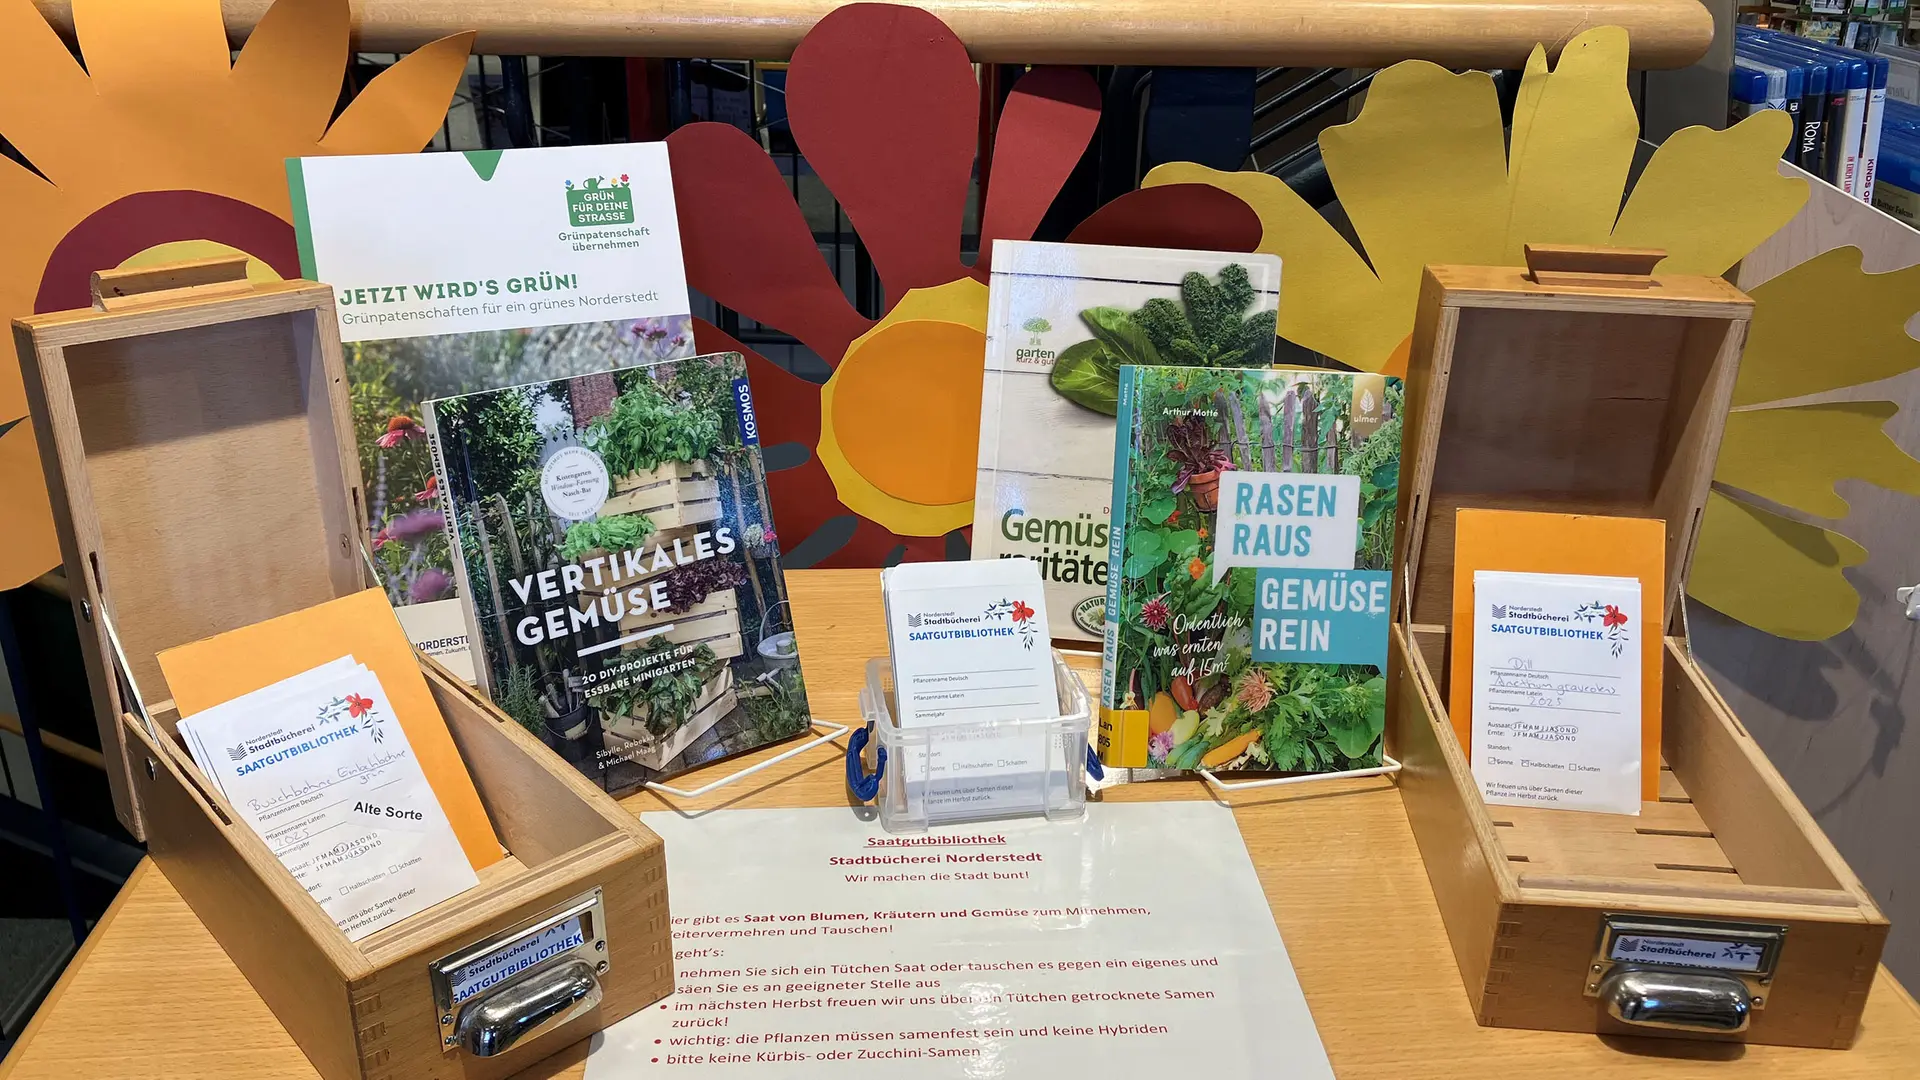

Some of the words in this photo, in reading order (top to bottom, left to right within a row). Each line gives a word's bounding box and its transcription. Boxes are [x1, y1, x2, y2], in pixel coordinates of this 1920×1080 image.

[1802, 121, 1821, 153] ROMA
[1865, 158, 1875, 188] KINDS
[573, 202, 593, 212] FÜR
[596, 201, 628, 211] DEINE
[584, 191, 614, 201] GRÜN
[578, 212, 625, 222] STRASSE
[559, 227, 650, 241] Grünpatenschaft
[573, 241, 639, 251] übernehmen
[339, 286, 407, 306] JETZT
[413, 279, 499, 301] WIRD'S
[506, 271, 578, 294] GRÜN!
[342, 304, 478, 325] Grünpatenschaften
[482, 301, 503, 316] für
[506, 300, 526, 313] ein
[529, 298, 575, 314] grünes
[579, 290, 658, 307] Norderstedt
[1016, 348, 1055, 359] garten
[738, 384, 757, 439] KOSMOS
[1162, 407, 1191, 416] Arthur
[1192, 408, 1219, 417] Motté
[1353, 414, 1379, 423] ulmer
[429, 432, 445, 476] GEMÜSE
[439, 478, 454, 540] VERTIKALES
[1235, 482, 1337, 517] RASEN
[1001, 508, 1108, 548] Gemüs
[1111, 526, 1122, 557] REIN
[1232, 523, 1312, 557] RAUS
[508, 527, 736, 606] VERTIKALES
[1108, 564, 1119, 616] GEMÜSE
[1261, 572, 1387, 613] GEMÜSE
[516, 580, 671, 646] GEMÜSE
[924, 616, 981, 625] Stadtbücherei
[1173, 611, 1245, 635] Ordentlich
[1509, 611, 1569, 622] Stadtbücherei
[909, 628, 1015, 641] SAATGUTBIBLIOTHEK
[1259, 618, 1330, 651] REIN
[1491, 624, 1604, 640] SAATGUTBIBLIOTHEK
[1105, 629, 1115, 662] RAUS
[1153, 643, 1180, 658] was
[1182, 636, 1224, 655] ernten
[582, 670, 597, 686] 20
[599, 649, 672, 681] DIY-PROJEKTE
[673, 644, 694, 658] FÜR
[1171, 658, 1196, 686] auf
[1508, 657, 1533, 671] Dill
[584, 676, 630, 699] ESSBARE
[632, 658, 696, 683] MINIGÄRTEN
[1099, 717, 1112, 731] Lan
[245, 728, 284, 746] Norderstedt
[248, 724, 316, 755] Stadtbücherei
[623, 735, 655, 751] Rebekka
[236, 724, 359, 777] SAATGUTBIBLIOTHEK
[598, 762, 605, 770] &
[606, 753, 635, 768] Michael
[258, 803, 300, 822] Pflanzenname
[300, 792, 324, 806] Deutsch
[354, 801, 381, 815] Alte
[385, 806, 423, 821] Sorte
[266, 820, 307, 841] Pflanzenname
[307, 813, 326, 825] Latein
[867, 834, 1007, 847] Saatgutbibliothek
[829, 854, 941, 866] Stadtbücherei
[946, 852, 1043, 864] Norderstedt
[845, 874, 869, 883] Wir
[873, 873, 925, 882] machen
[930, 872, 951, 881] die
[954, 871, 989, 881] Stadt
[993, 871, 1030, 880] bunt!
[671, 915, 689, 925] ier
[693, 914, 721, 926] gibt
[743, 913, 775, 923] Saat
[779, 914, 806, 922] von
[810, 911, 869, 922] Blumen,
[873, 909, 936, 920] Kräutern
[940, 908, 967, 918] und
[971, 907, 1029, 917] Gemüse
[1032, 908, 1062, 916] zum
[1066, 906, 1151, 916] Mitnehmen,
[671, 927, 786, 939] eitervermehren
[793, 926, 816, 935] und
[821, 924, 893, 934] Tauschen!
[1640, 945, 1716, 959] Stadtbücherei
[1642, 939, 1685, 947] Norderstedt
[469, 937, 540, 977] Stadtbücherei
[680, 968, 741, 978] nehmen
[745, 967, 767, 976] Sie
[771, 966, 799, 975] sich
[803, 965, 826, 974] ein
[831, 964, 889, 974] Tütchen
[894, 963, 926, 972] Saat
[930, 962, 963, 972] oder
[968, 961, 1033, 971] tauschen
[1038, 961, 1054, 969] es
[1058, 960, 1101, 971] gegen
[1105, 959, 1128, 968] ein
[1131, 957, 1187, 969] eigenes
[1190, 956, 1219, 966] und
[453, 933, 583, 1004] SAATGUTBIBLIOTHEK
[677, 984, 712, 994] säen
[716, 983, 738, 993] Sie
[742, 984, 759, 992] es
[763, 983, 782, 992] an
[785, 980, 866, 993] geeigneter
[870, 978, 911, 989] Stelle
[914, 979, 941, 988] aus
[674, 1001, 694, 1011] im
[698, 999, 767, 1010] nächsten
[771, 998, 823, 1009] Herbst
[826, 996, 877, 1007] freuen
[880, 996, 905, 1006] wir
[909, 996, 936, 1005] uns
[1006, 992, 1067, 1003] Tütchen
[1071, 990, 1161, 1003] getrocknete
[1164, 989, 1216, 999] Samen
[672, 1017, 729, 1028] zurück!
[669, 1033, 731, 1047] wichtig:
[735, 1033, 760, 1045] die
[763, 1032, 830, 1043] Pflanzen
[835, 1030, 895, 1042] müssen
[898, 1028, 980, 1040] samenfest
[983, 1027, 1014, 1038] sein
[1019, 1026, 1048, 1037] und
[1052, 1025, 1095, 1036] keine
[1098, 1024, 1168, 1036] Hybriden
[666, 1053, 704, 1065] bitte
[708, 1052, 751, 1064] keine
[756, 1051, 811, 1062] Kürbis-
[815, 1050, 853, 1061] oder
[857, 1047, 981, 1059] Zucchini-Samen
